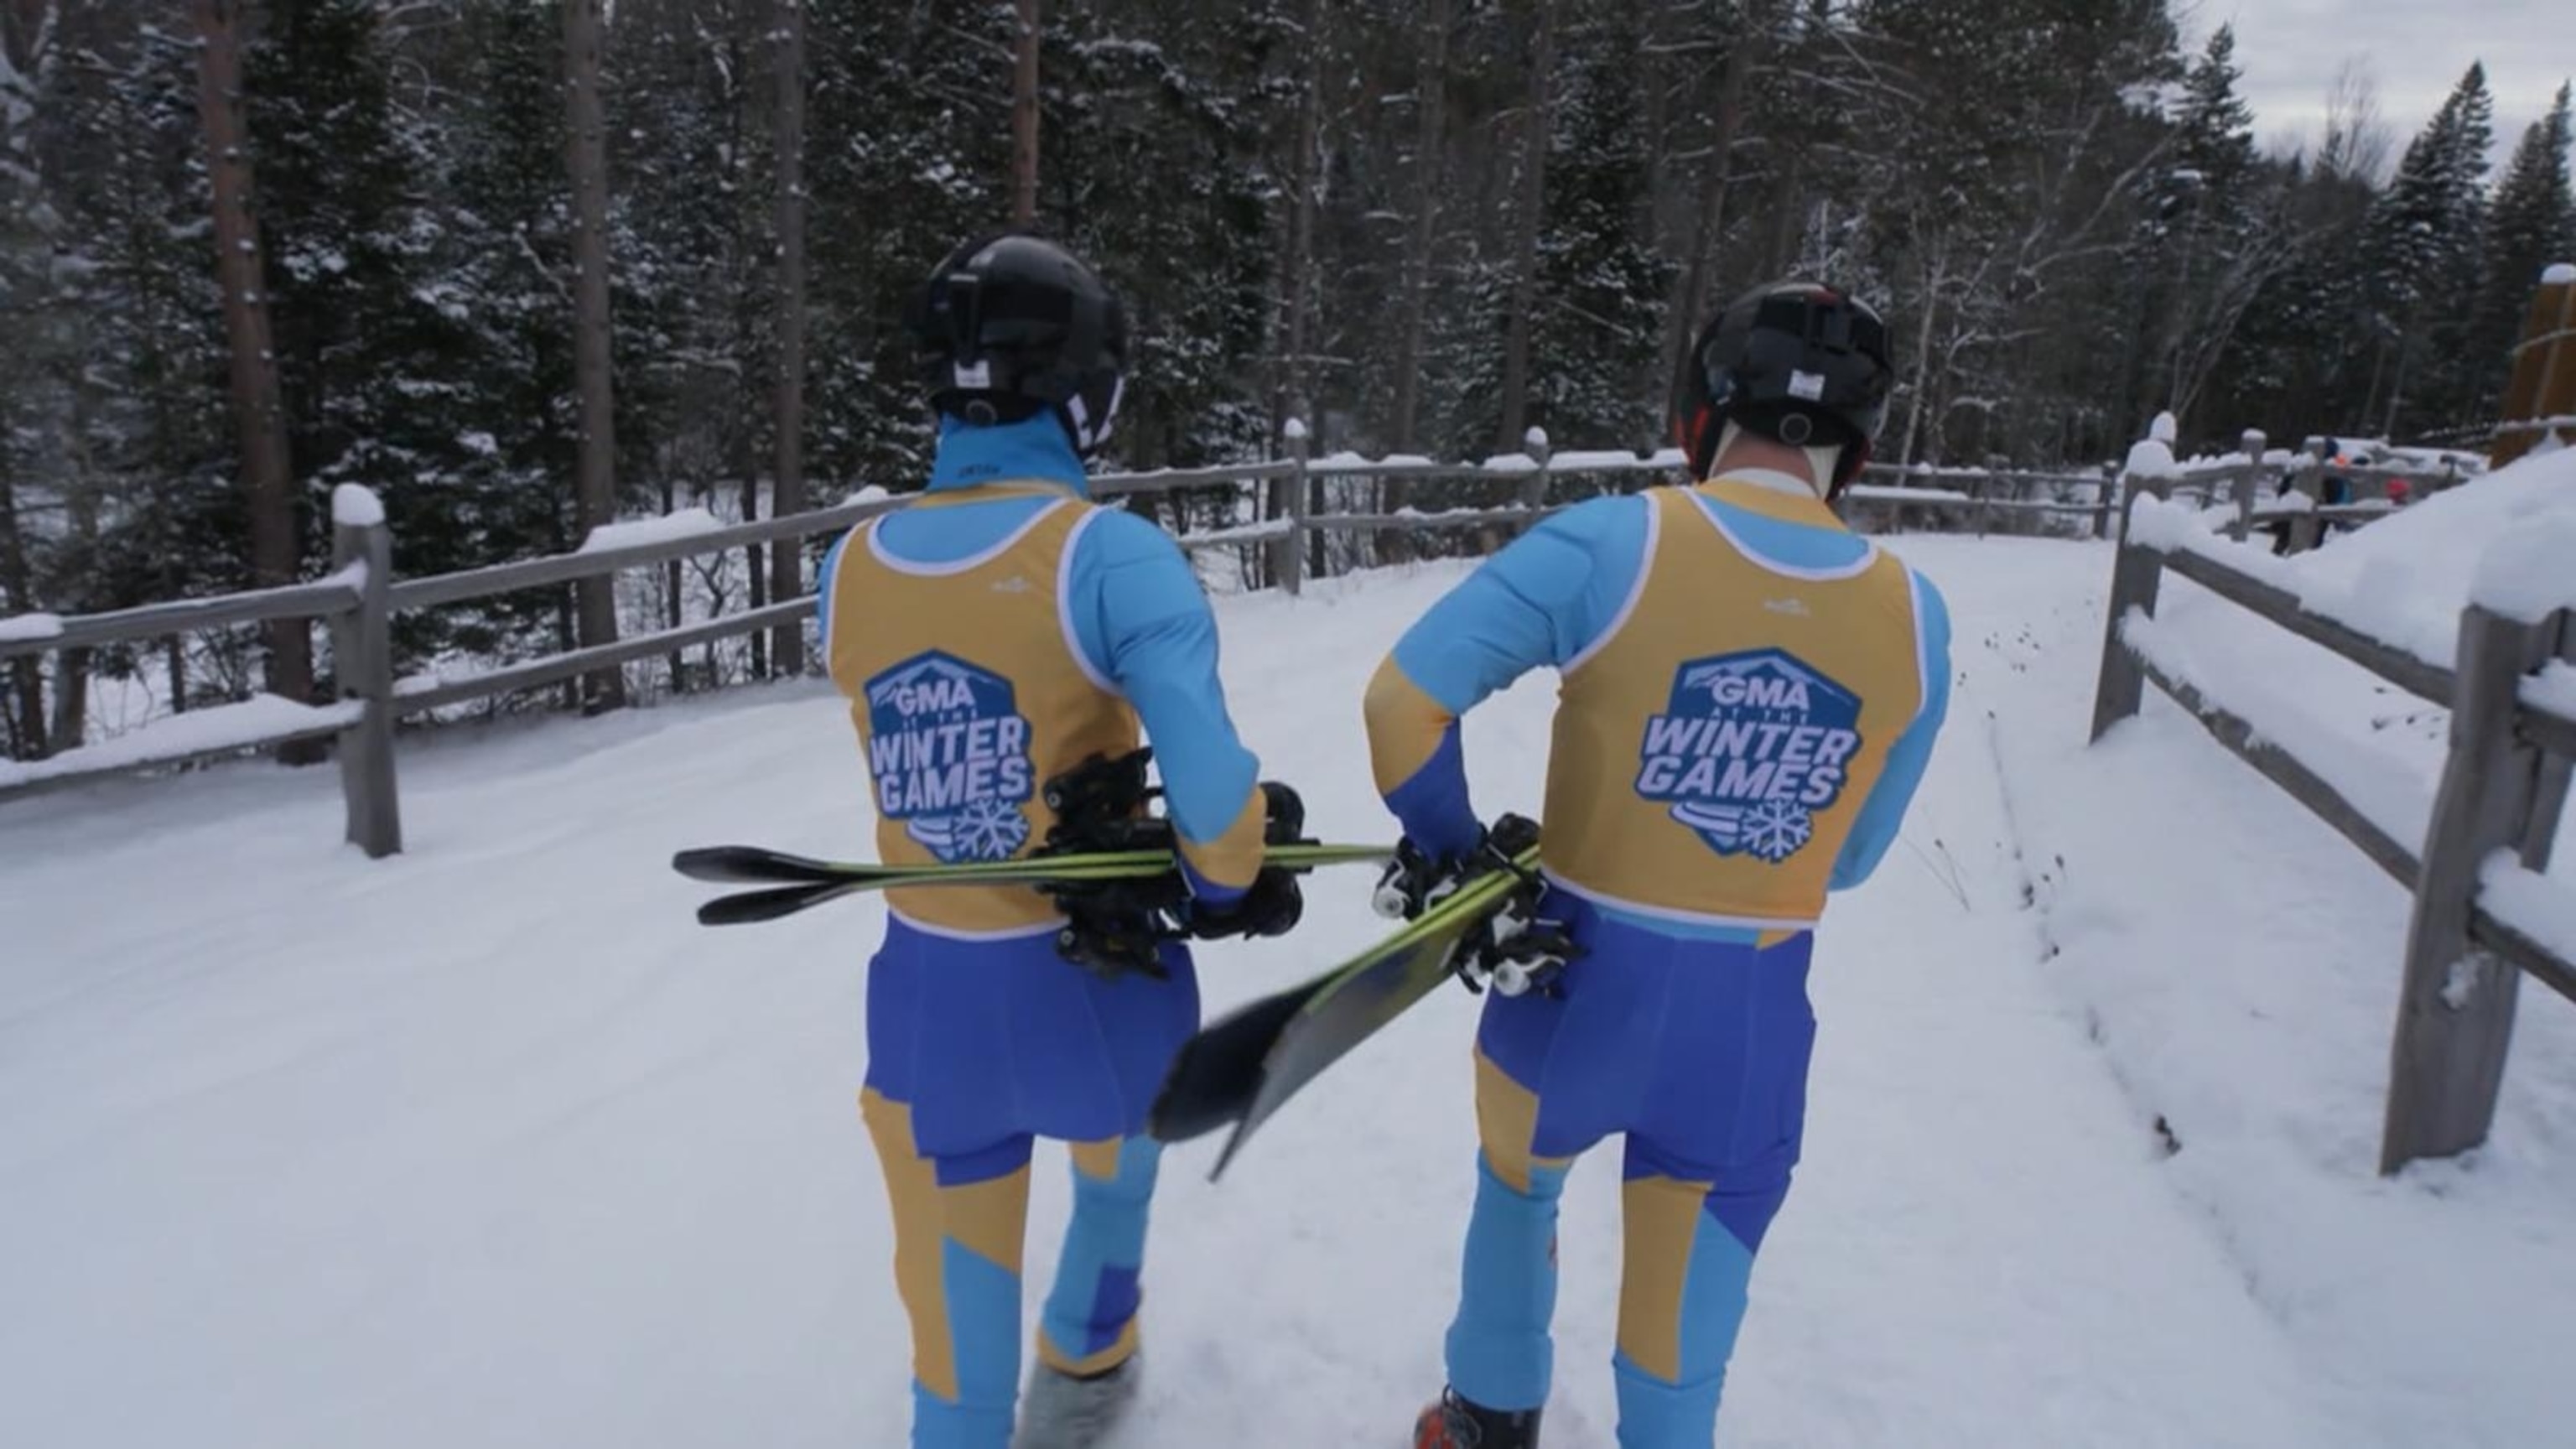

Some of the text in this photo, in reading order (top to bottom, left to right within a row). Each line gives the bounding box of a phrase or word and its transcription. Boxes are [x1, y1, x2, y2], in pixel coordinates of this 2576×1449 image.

[896, 678, 975, 716] GMA
[1711, 675, 1810, 710] GMA
[870, 716, 1024, 775] WINTER
[1644, 717, 1857, 765] WINTER
[881, 756, 1027, 813] GAMES
[1637, 756, 1841, 803] GAMES
